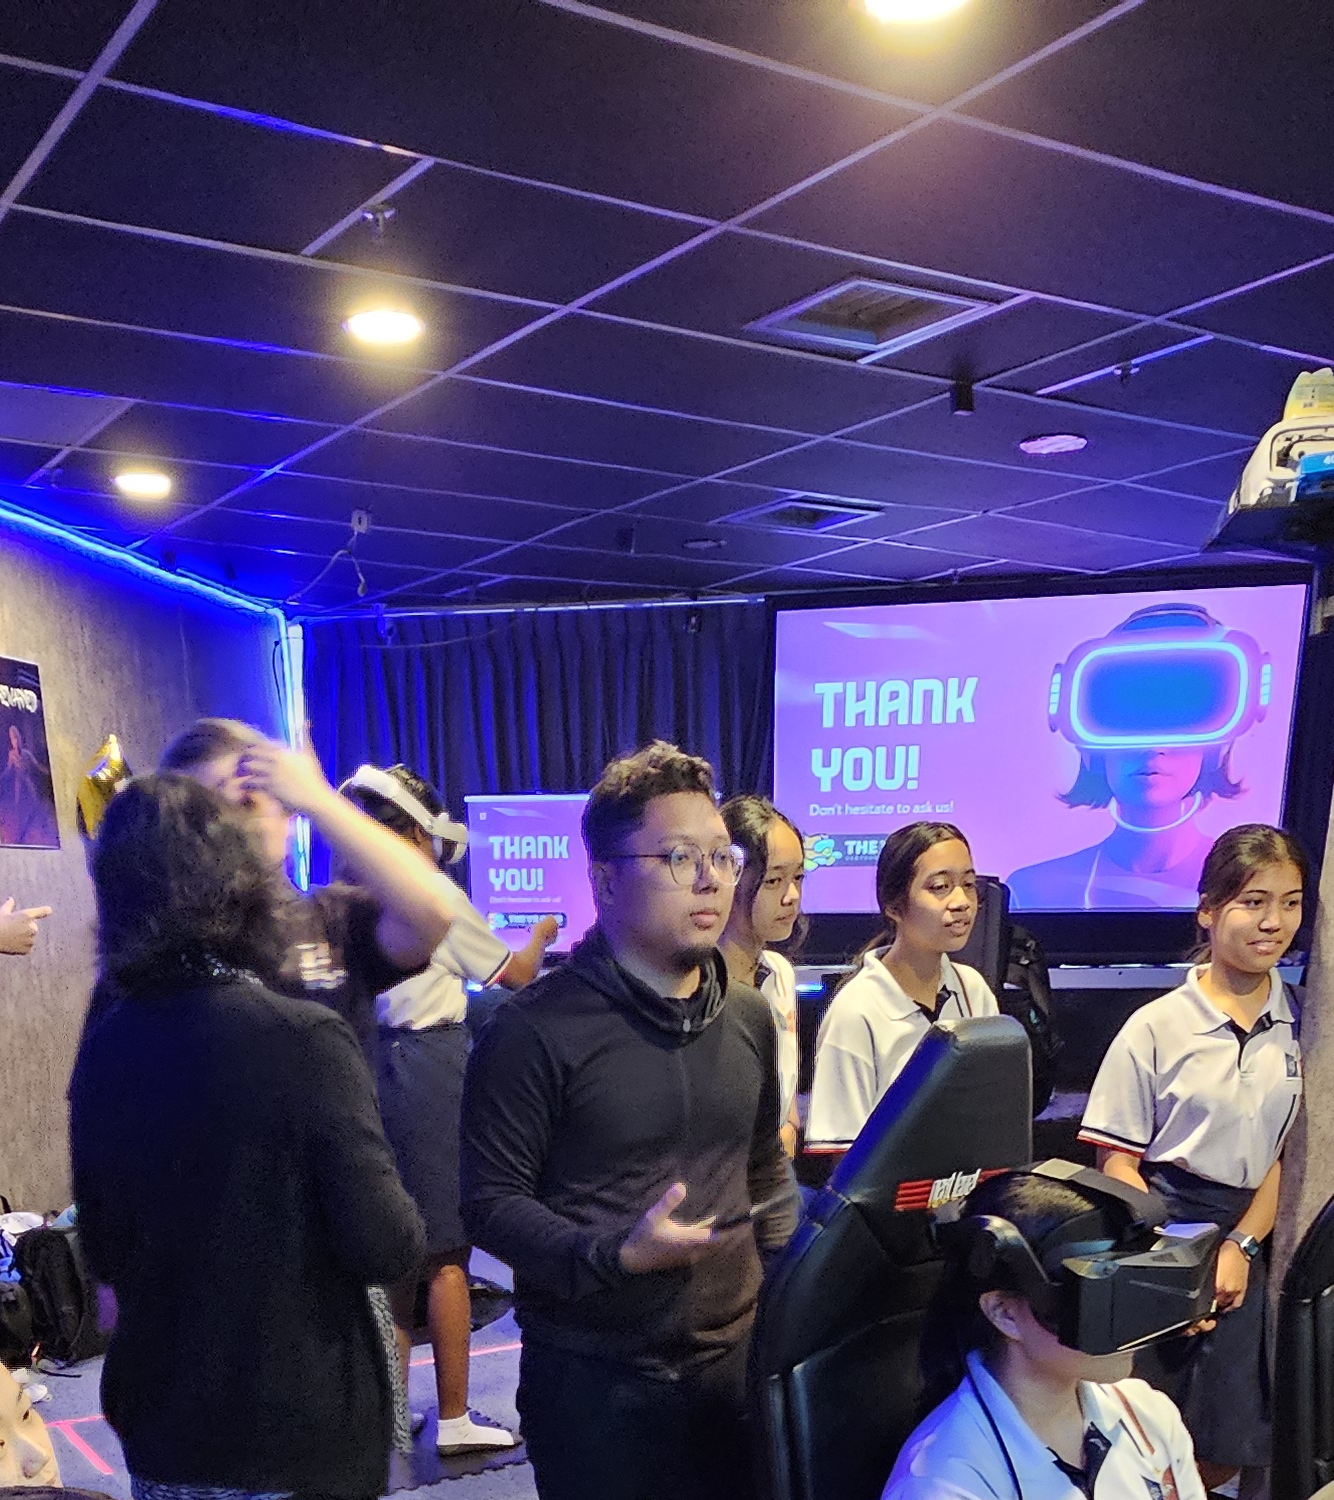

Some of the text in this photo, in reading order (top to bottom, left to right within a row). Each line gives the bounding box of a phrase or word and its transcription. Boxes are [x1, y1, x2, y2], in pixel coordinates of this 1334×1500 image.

[814, 677, 979, 728] THANK
[811, 745, 920, 792] YOU!
[809, 801, 955, 817] Don't hesitate to ask us!
[489, 836, 569, 860] THANK
[844, 840, 878, 855] THE
[489, 868, 544, 891] YOU!
